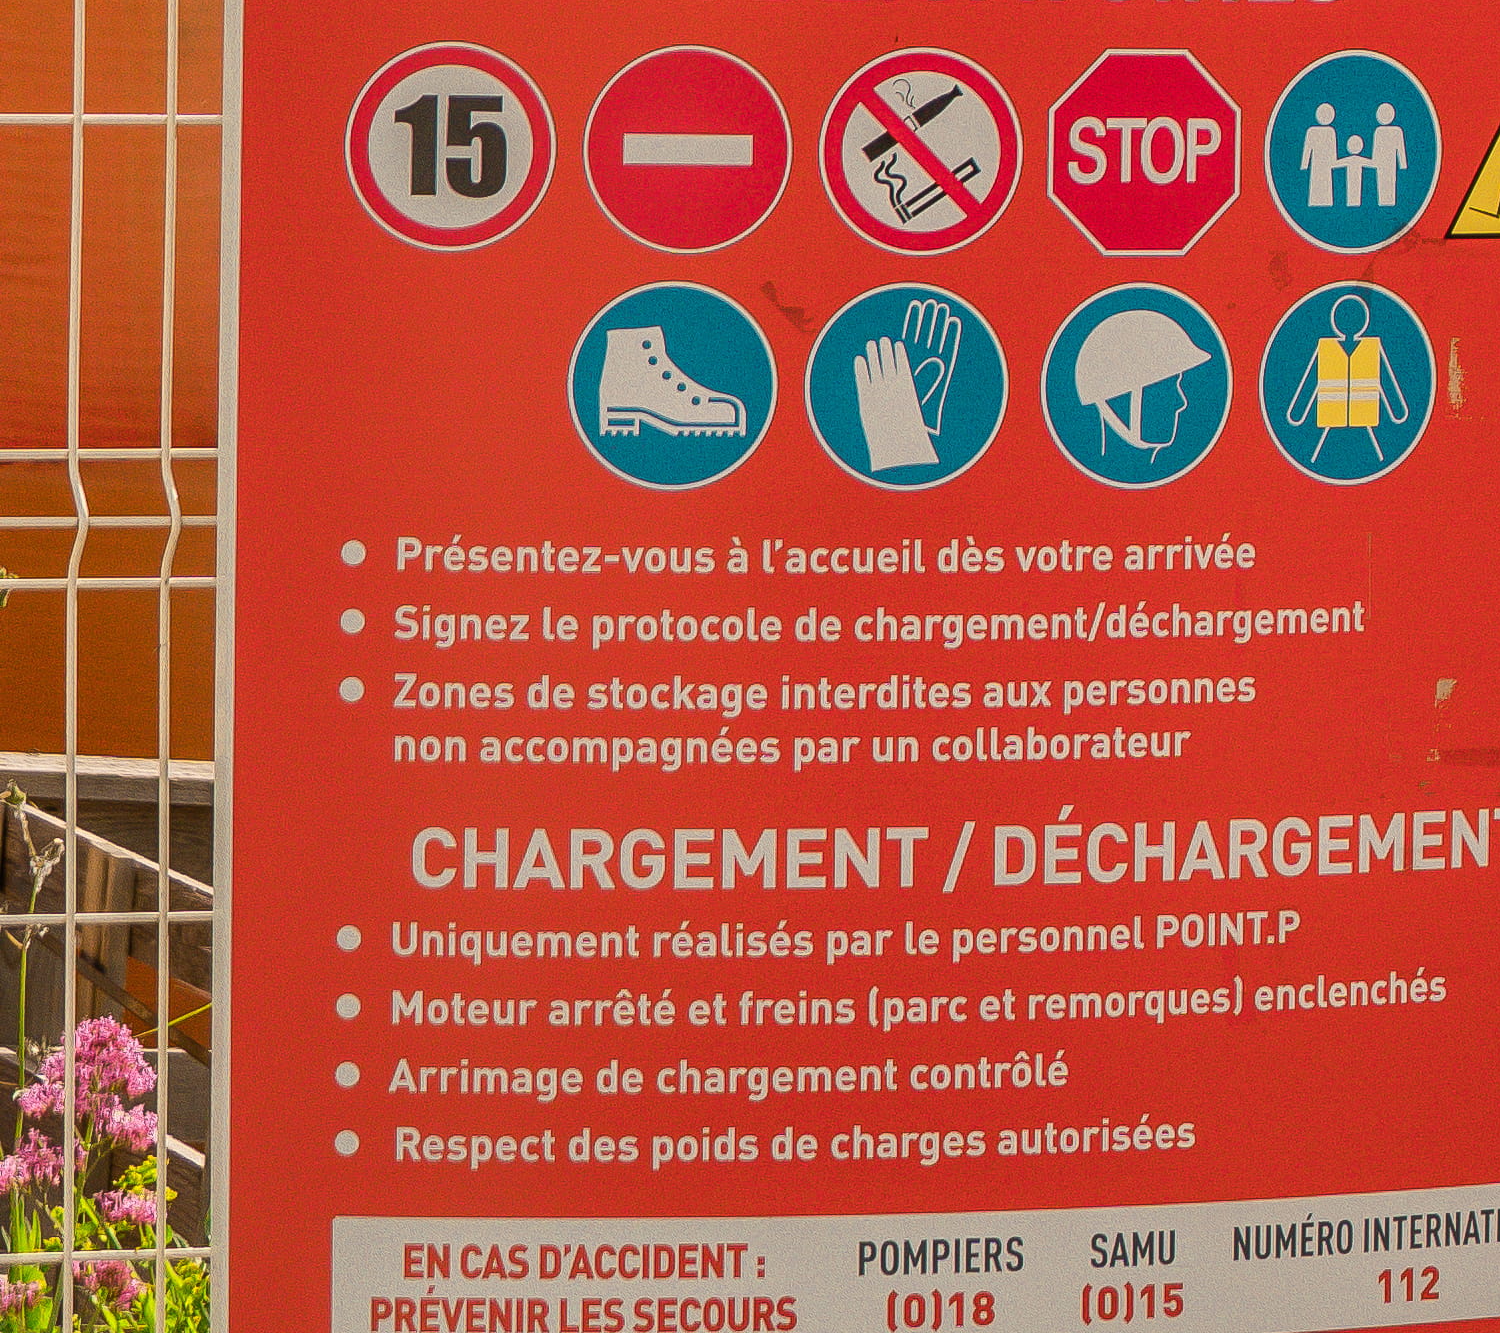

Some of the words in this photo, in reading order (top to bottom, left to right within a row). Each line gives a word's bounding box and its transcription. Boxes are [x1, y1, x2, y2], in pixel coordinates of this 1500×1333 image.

[395, 95, 506, 198] 15
[1068, 117, 1221, 184] STOP
[397, 535, 715, 573] Présentez-vous
[727, 537, 748, 573] à
[938, 536, 1004, 573] dès
[1016, 541, 1113, 572] votre
[1124, 533, 1255, 570] arrivée
[395, 605, 529, 648] Signez
[543, 607, 578, 641] le
[593, 608, 781, 649] protocole
[795, 608, 841, 641] de
[855, 601, 1364, 649] chargement/déchargement
[394, 674, 514, 709] Zones
[527, 675, 574, 709] de
[587, 676, 767, 718] stockage
[782, 675, 971, 709] interdites
[983, 682, 1051, 707] aux
[1064, 677, 1255, 714] personnes
[394, 736, 466, 762] non
[480, 727, 780, 772] accompagnées
[794, 737, 860, 771] par
[873, 737, 918, 762] un
[932, 727, 1190, 761] collaborateur
[412, 827, 928, 889] CHARGEMENT
[943, 823, 975, 892] /
[392, 922, 639, 965] Uniquement
[653, 921, 813, 957] réalisés
[827, 930, 893, 965] par
[905, 922, 939, 955] le
[953, 916, 1144, 962] personnel
[1157, 911, 1300, 948] POINT.P
[392, 990, 537, 1025] Moteur
[549, 989, 676, 1025] arrêté
[689, 994, 726, 1025] et
[739, 991, 855, 1025] freins
[869, 987, 967, 1031] (parc
[980, 989, 1015, 1021] et
[1029, 976, 1242, 1023] remorques)
[1255, 967, 1446, 1011] enclenchés
[389, 1059, 583, 1102] Arrimage
[597, 1060, 643, 1093] de
[657, 1060, 897, 1101] chargement
[910, 1050, 1068, 1090] contrôlé
[396, 1127, 555, 1170] Respect
[569, 1128, 638, 1162] des
[652, 1128, 758, 1170] poids
[772, 1127, 817, 1160] de
[831, 1126, 985, 1166] charges
[998, 1114, 1195, 1155] autorisées
[859, 1237, 1023, 1276] POMPIERS
[1091, 1231, 1175, 1268] SAMU
[1234, 1213, 1353, 1261] NUMÉRO
[404, 1244, 450, 1278] EN
[461, 1244, 529, 1279] CAS
[1379, 1266, 1439, 1303] 112
[371, 1285, 549, 1333] PRÉVENIR
[562, 1298, 624, 1333] LES
[633, 1296, 797, 1333] SECOURS
[887, 1290, 995, 1333] (0)18
[1082, 1282, 1183, 1325] (0)15
